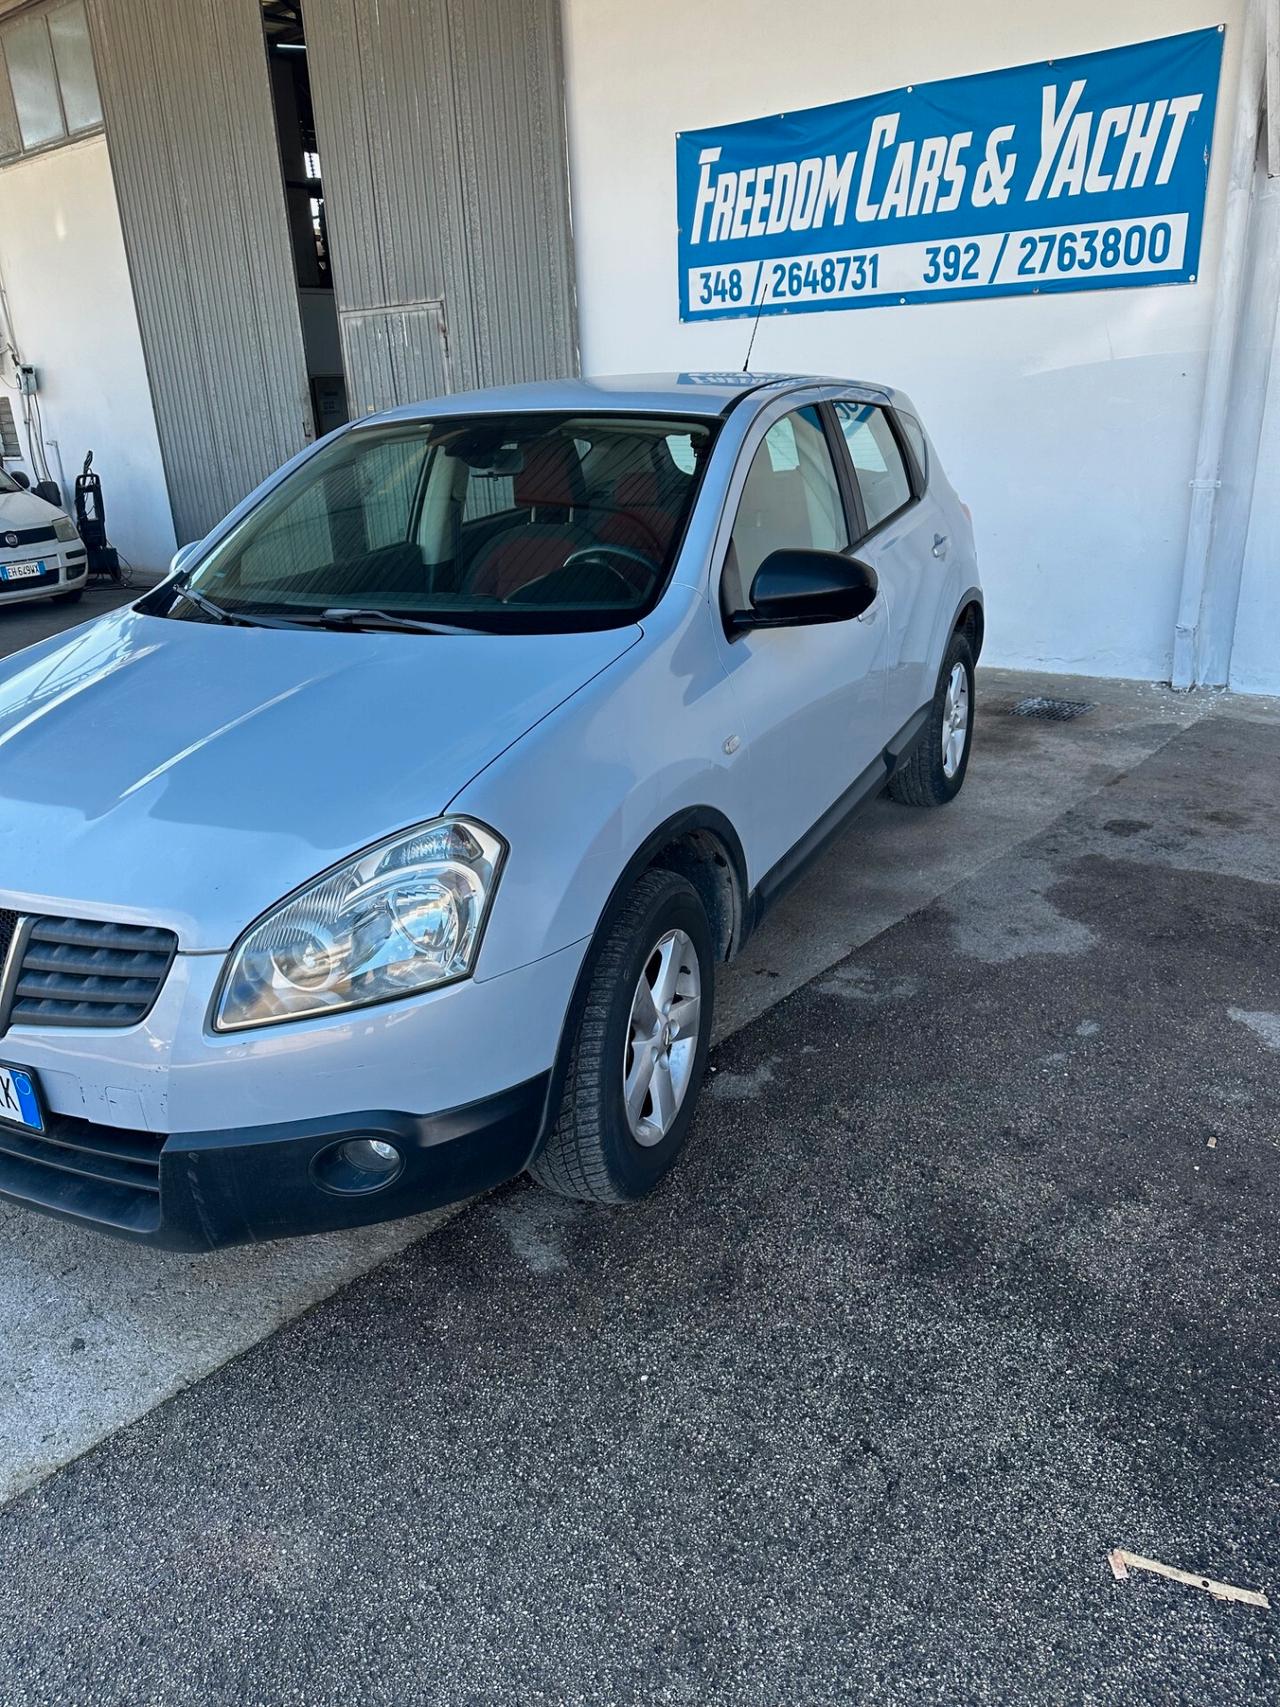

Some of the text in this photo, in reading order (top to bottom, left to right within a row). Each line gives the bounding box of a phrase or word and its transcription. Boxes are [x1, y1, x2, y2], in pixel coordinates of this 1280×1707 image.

[690, 79, 1203, 245] FREEDOM CARS & YACHT
